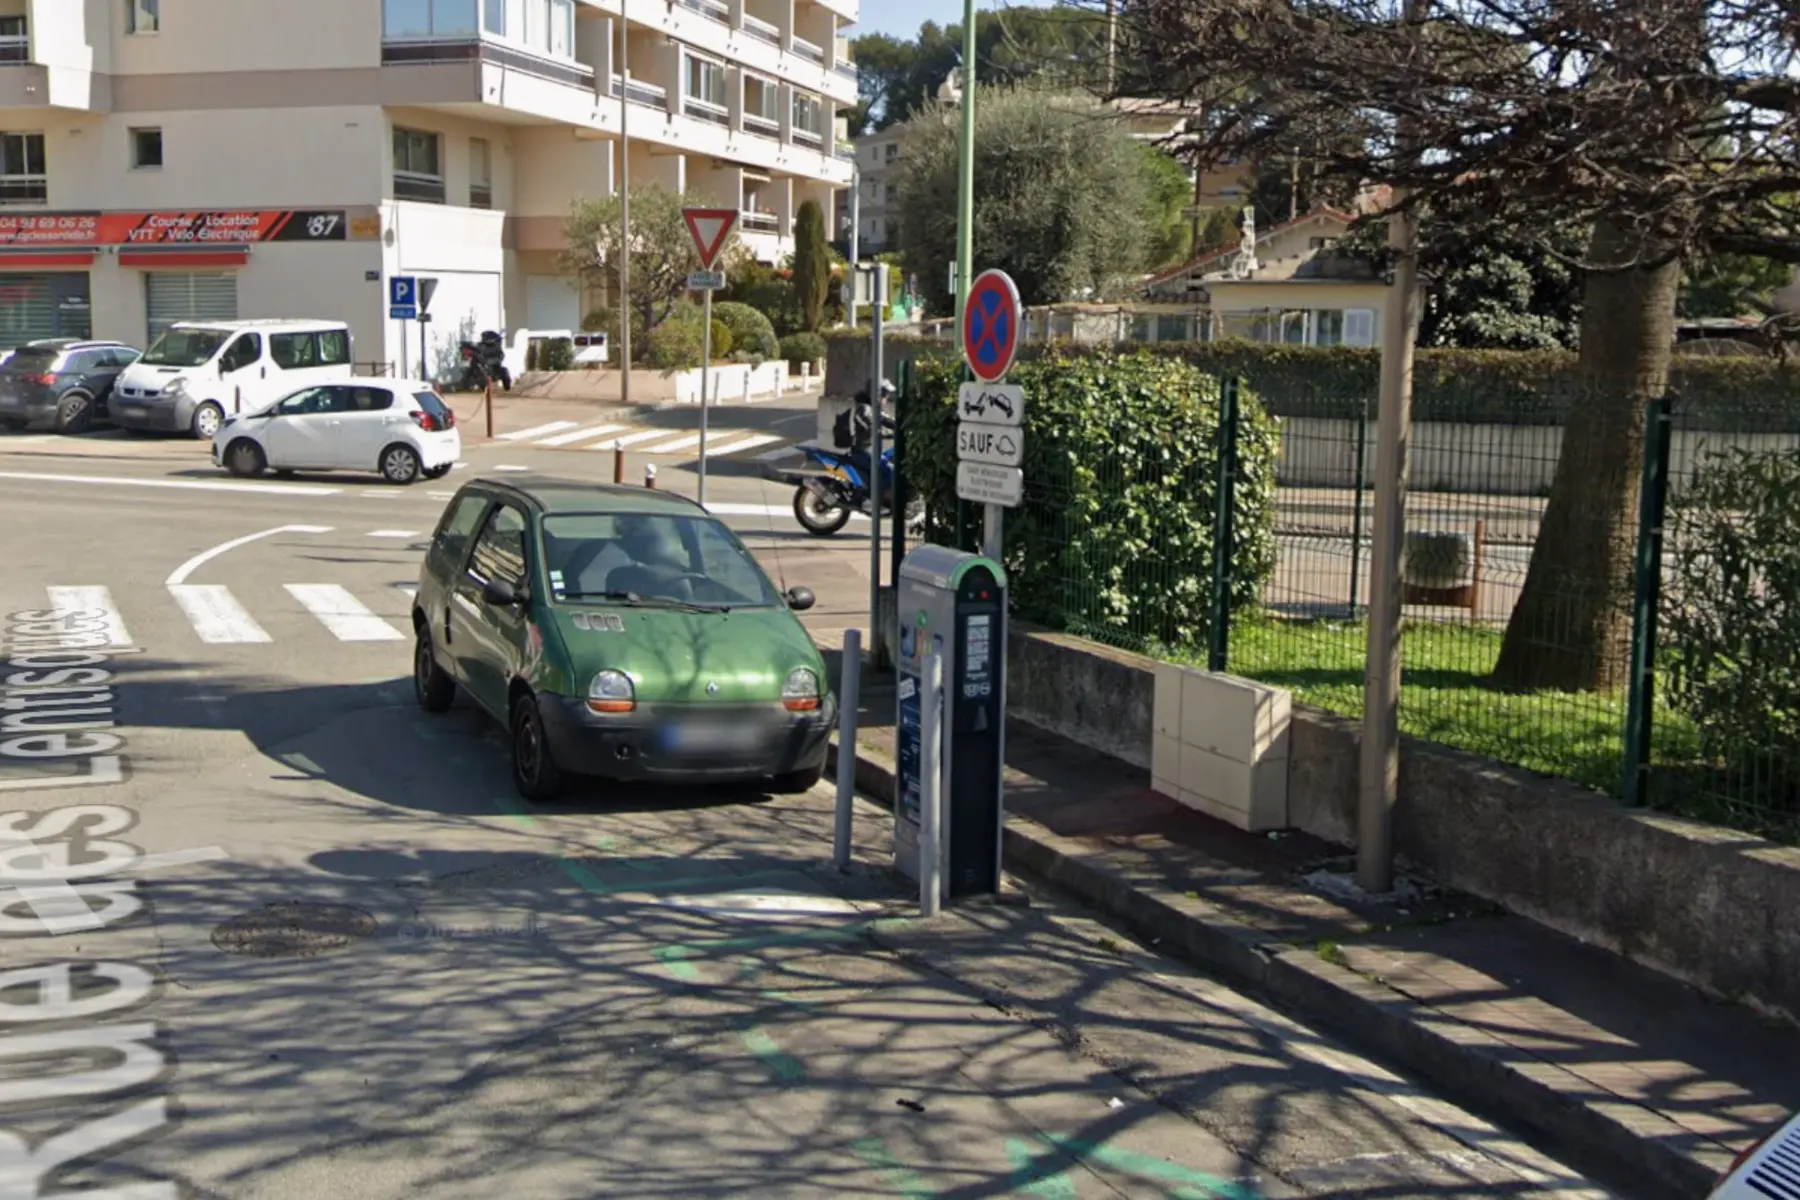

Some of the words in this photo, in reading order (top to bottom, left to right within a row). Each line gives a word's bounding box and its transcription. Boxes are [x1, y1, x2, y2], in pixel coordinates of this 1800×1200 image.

[206, 214, 258, 227] Location
[129, 228, 154, 241] VTT
[395, 282, 409, 301] P
[960, 430, 994, 455] SAUF
